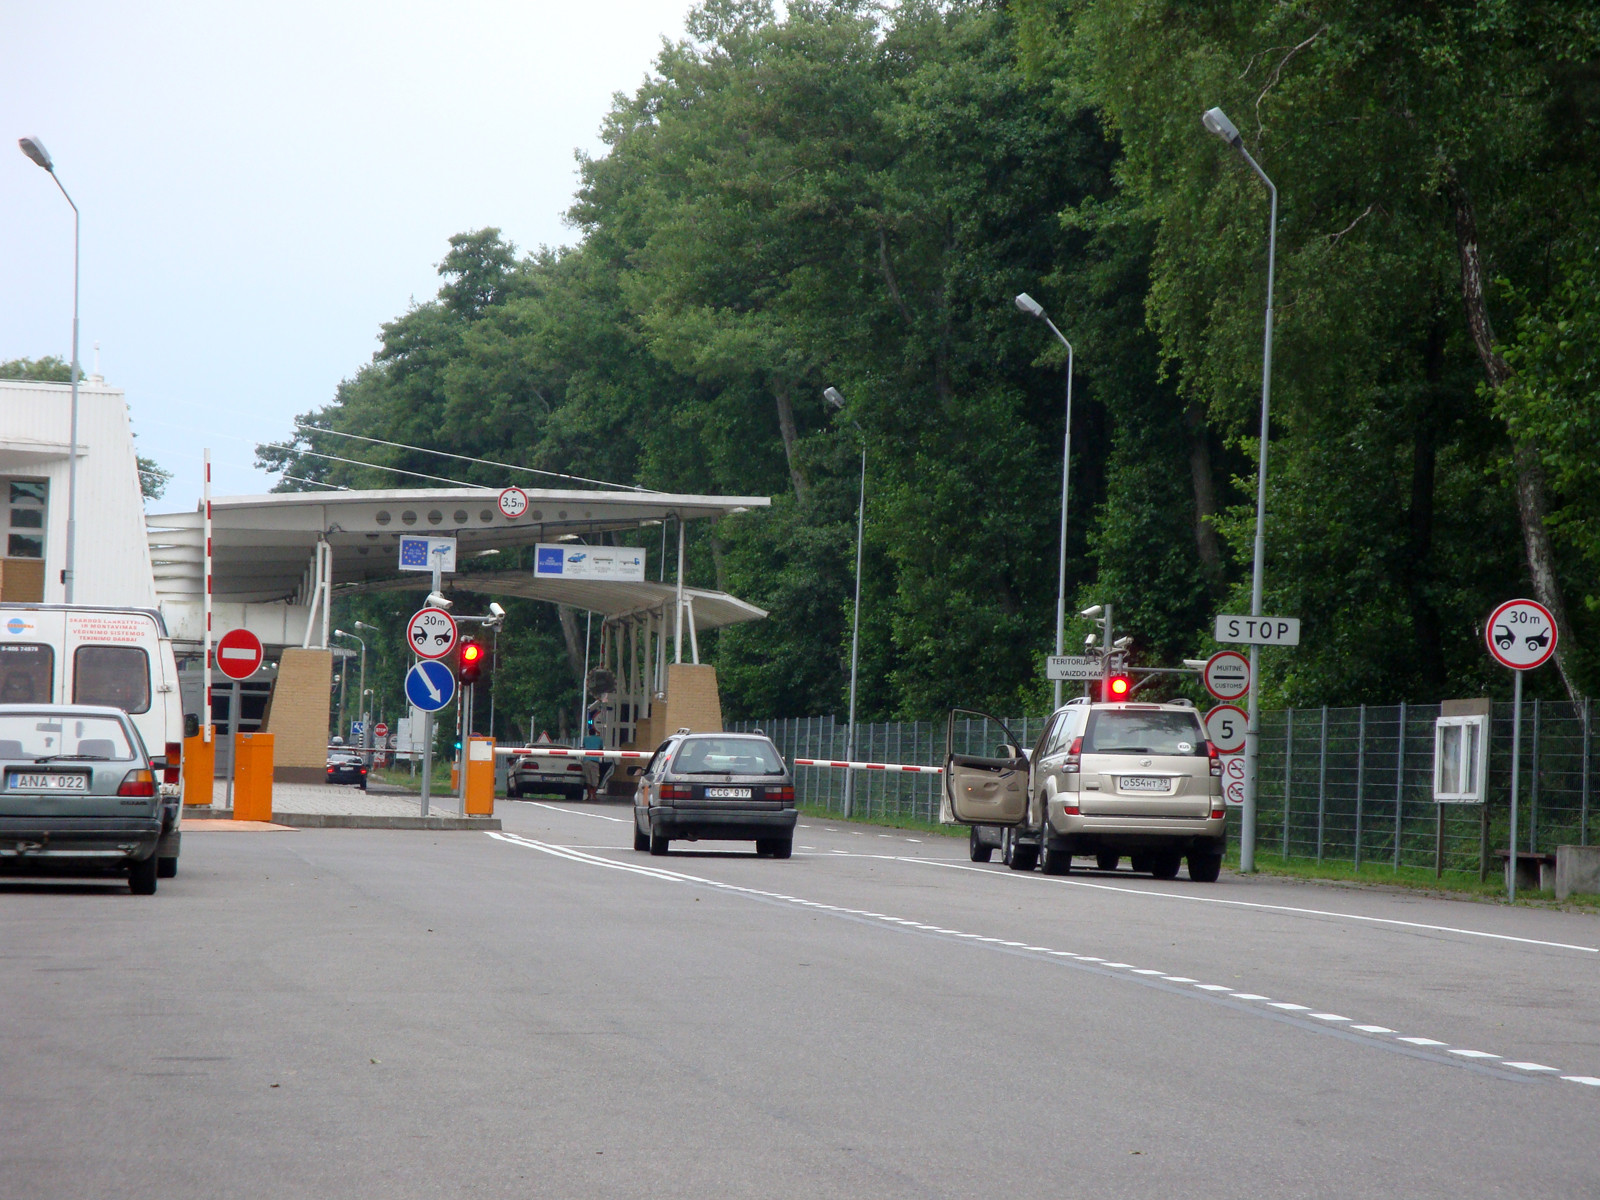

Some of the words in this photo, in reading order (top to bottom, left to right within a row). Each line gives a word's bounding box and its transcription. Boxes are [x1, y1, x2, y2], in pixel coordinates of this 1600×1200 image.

[1228, 620, 1289, 639] STOP
[1221, 720, 1233, 739] 5
[20, 776, 48, 787] ANA
[58, 777, 83, 788] 022
[710, 788, 729, 796] CCG
[735, 788, 749, 796] 917
